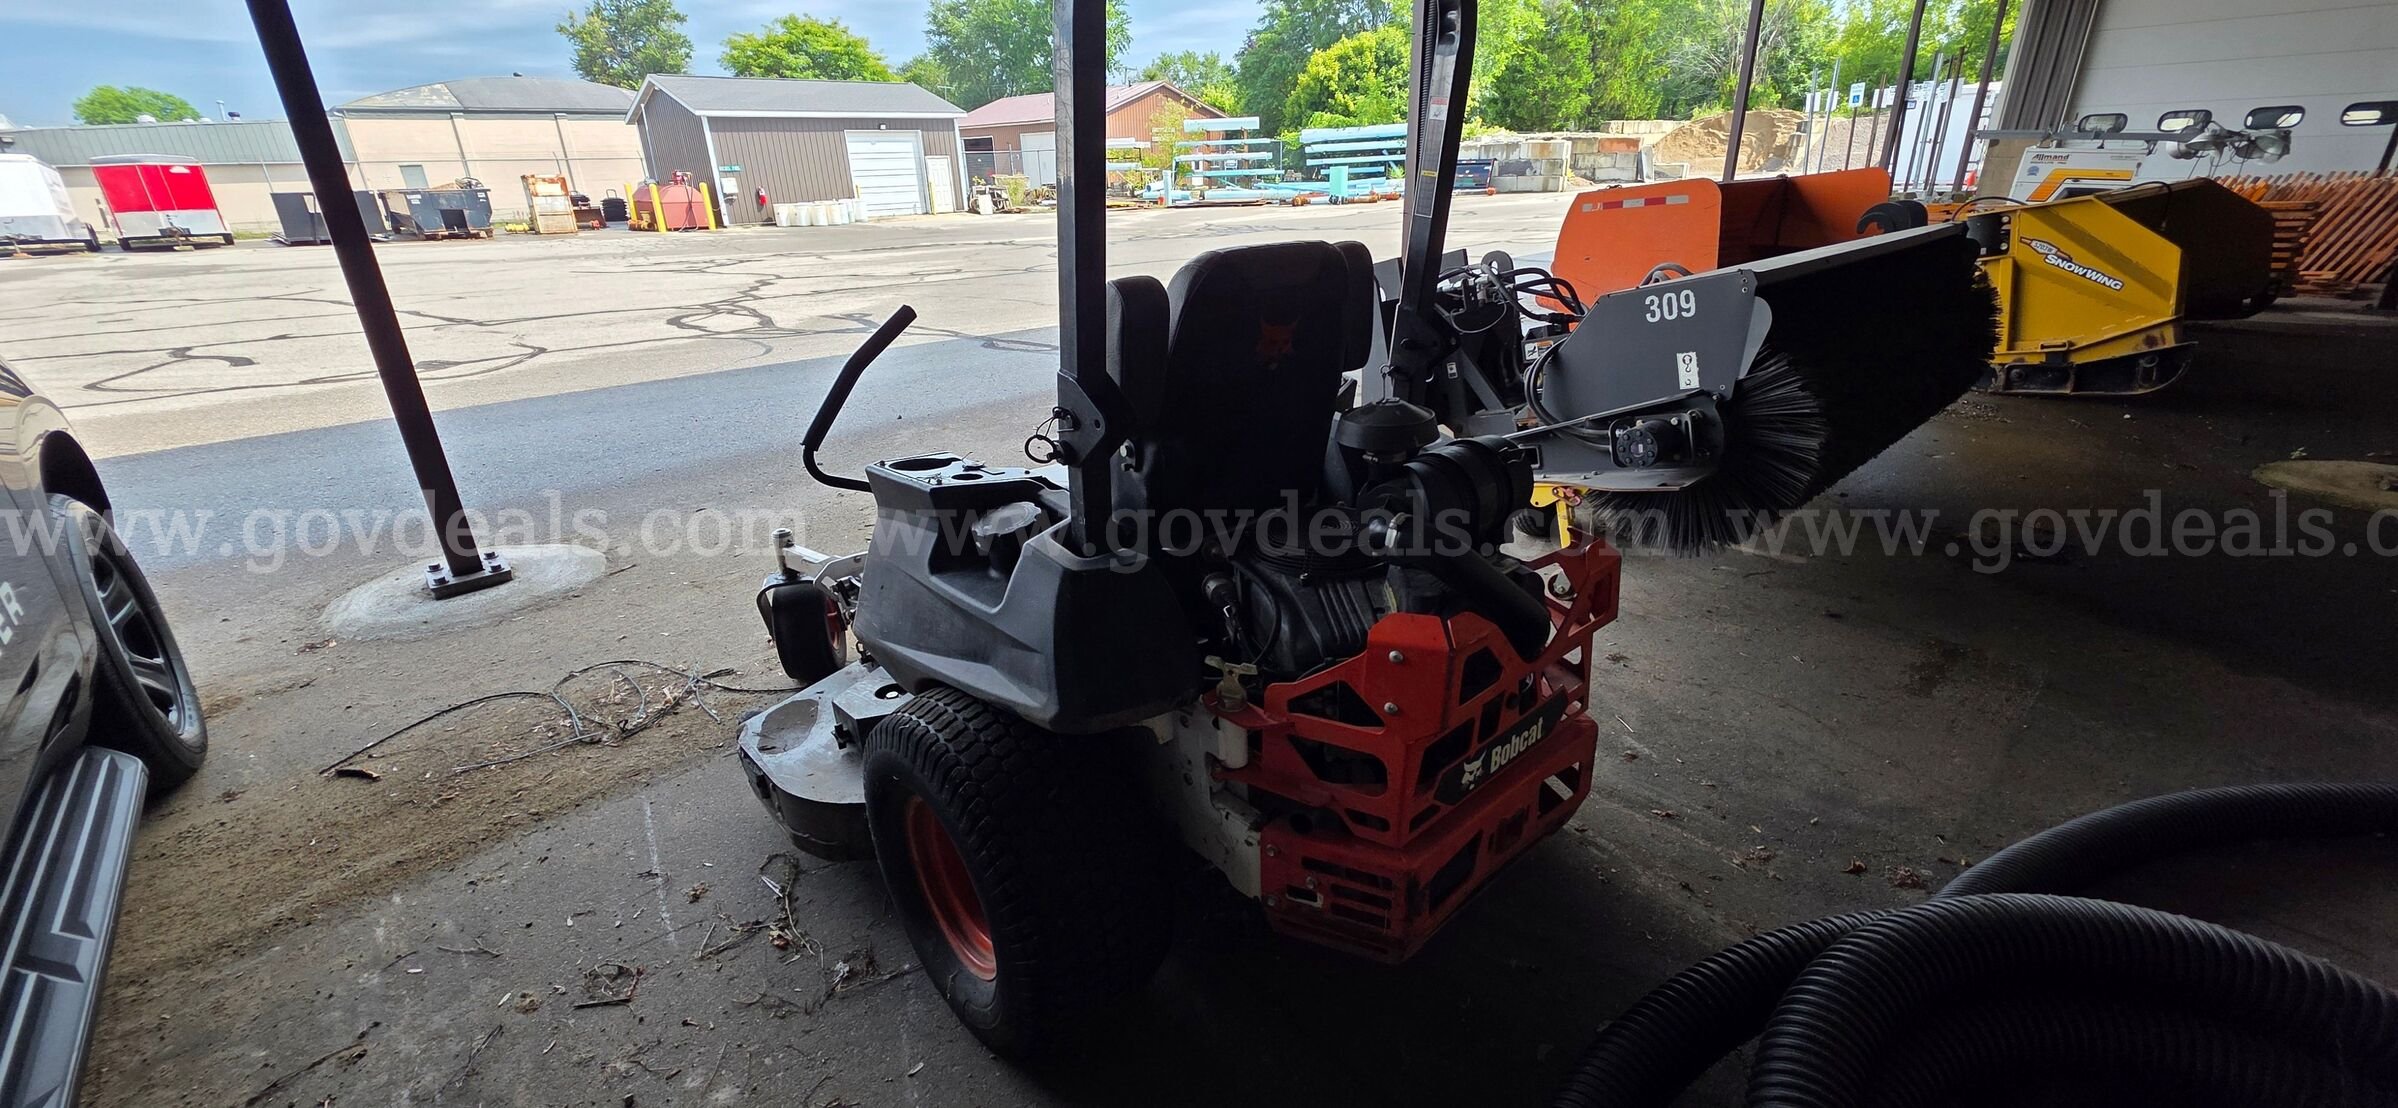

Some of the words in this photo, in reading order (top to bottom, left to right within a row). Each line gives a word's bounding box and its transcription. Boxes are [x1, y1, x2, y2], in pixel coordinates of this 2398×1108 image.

[2031, 153, 2070, 161] Allmand
[1644, 289, 1696, 323] 309
[1489, 716, 1544, 775] Bobcat
